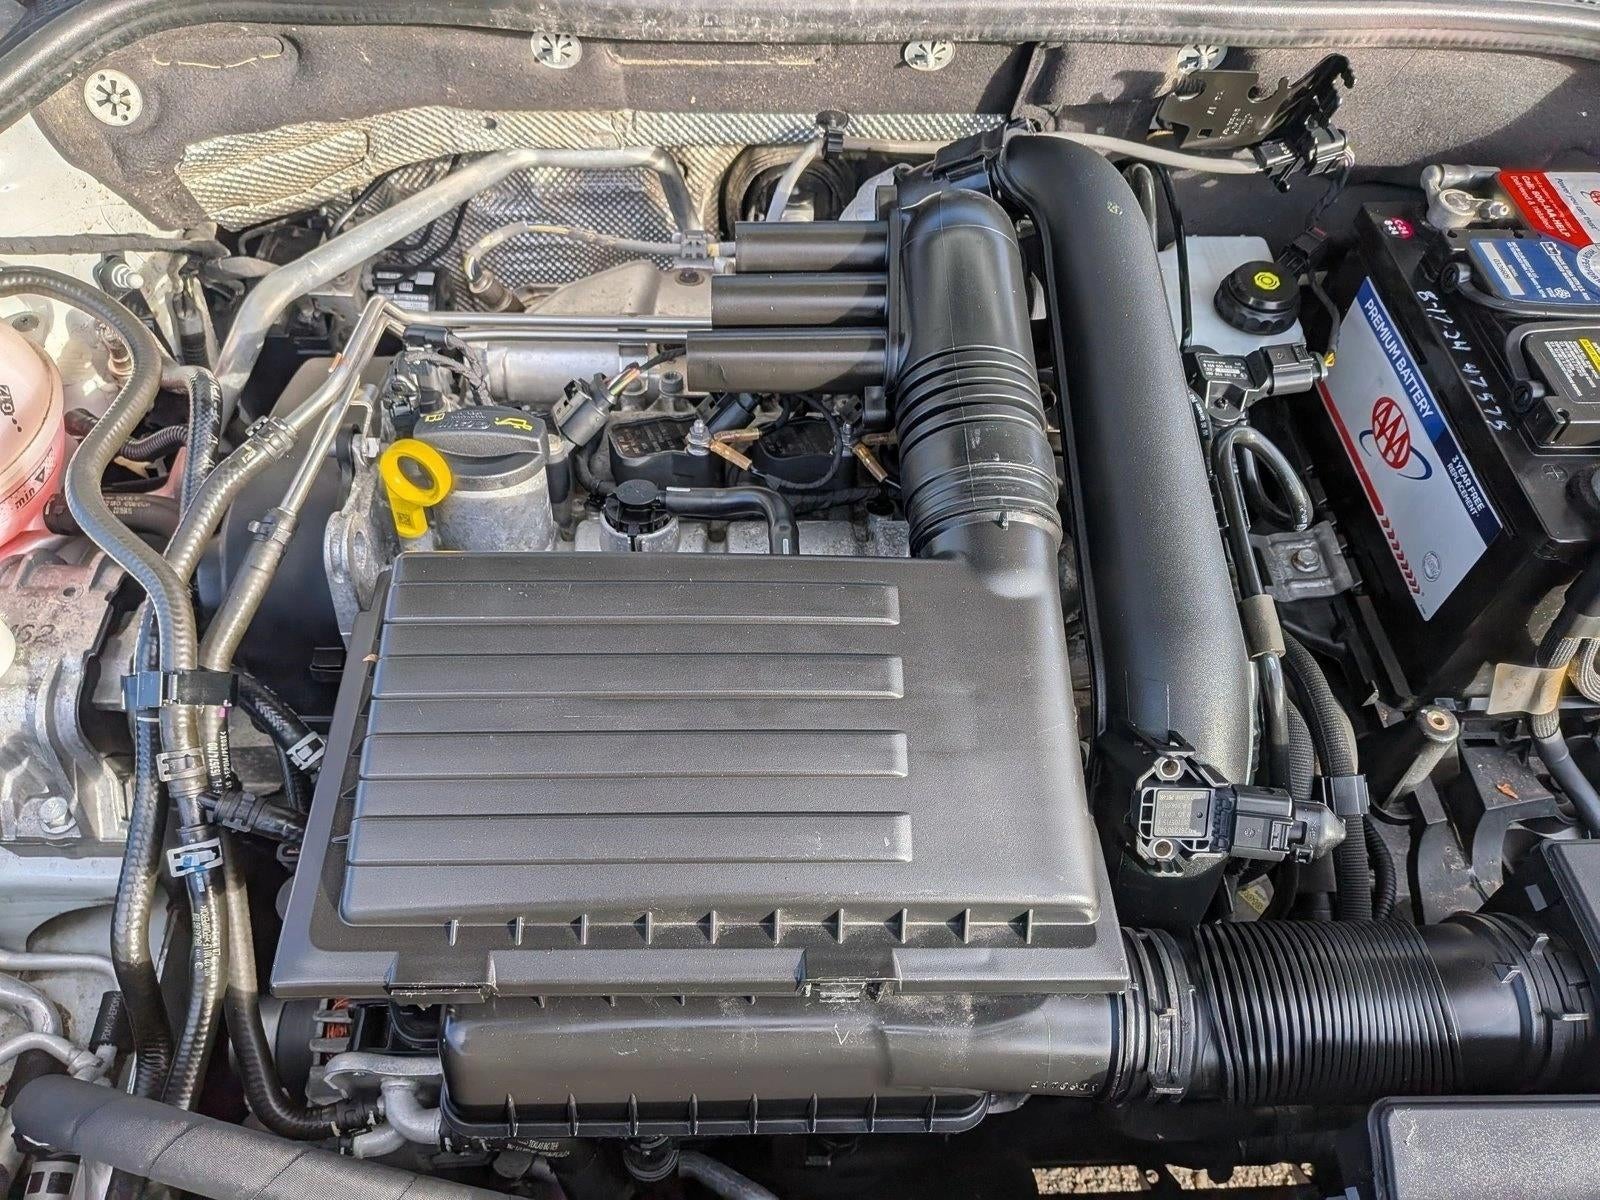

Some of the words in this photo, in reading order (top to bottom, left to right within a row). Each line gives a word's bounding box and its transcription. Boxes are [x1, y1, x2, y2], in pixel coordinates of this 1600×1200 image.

[1364, 299, 1400, 361] PREMIUM
[1396, 357, 1434, 418] BATTERY
[1373, 400, 1410, 464] AAA
[15, 487, 35, 509] min
[1447, 463, 1478, 517] REPLACEMENT
[1451, 454, 1460, 463] 3
[1456, 461, 1473, 488] YEAR
[1467, 486, 1485, 512] FREE
